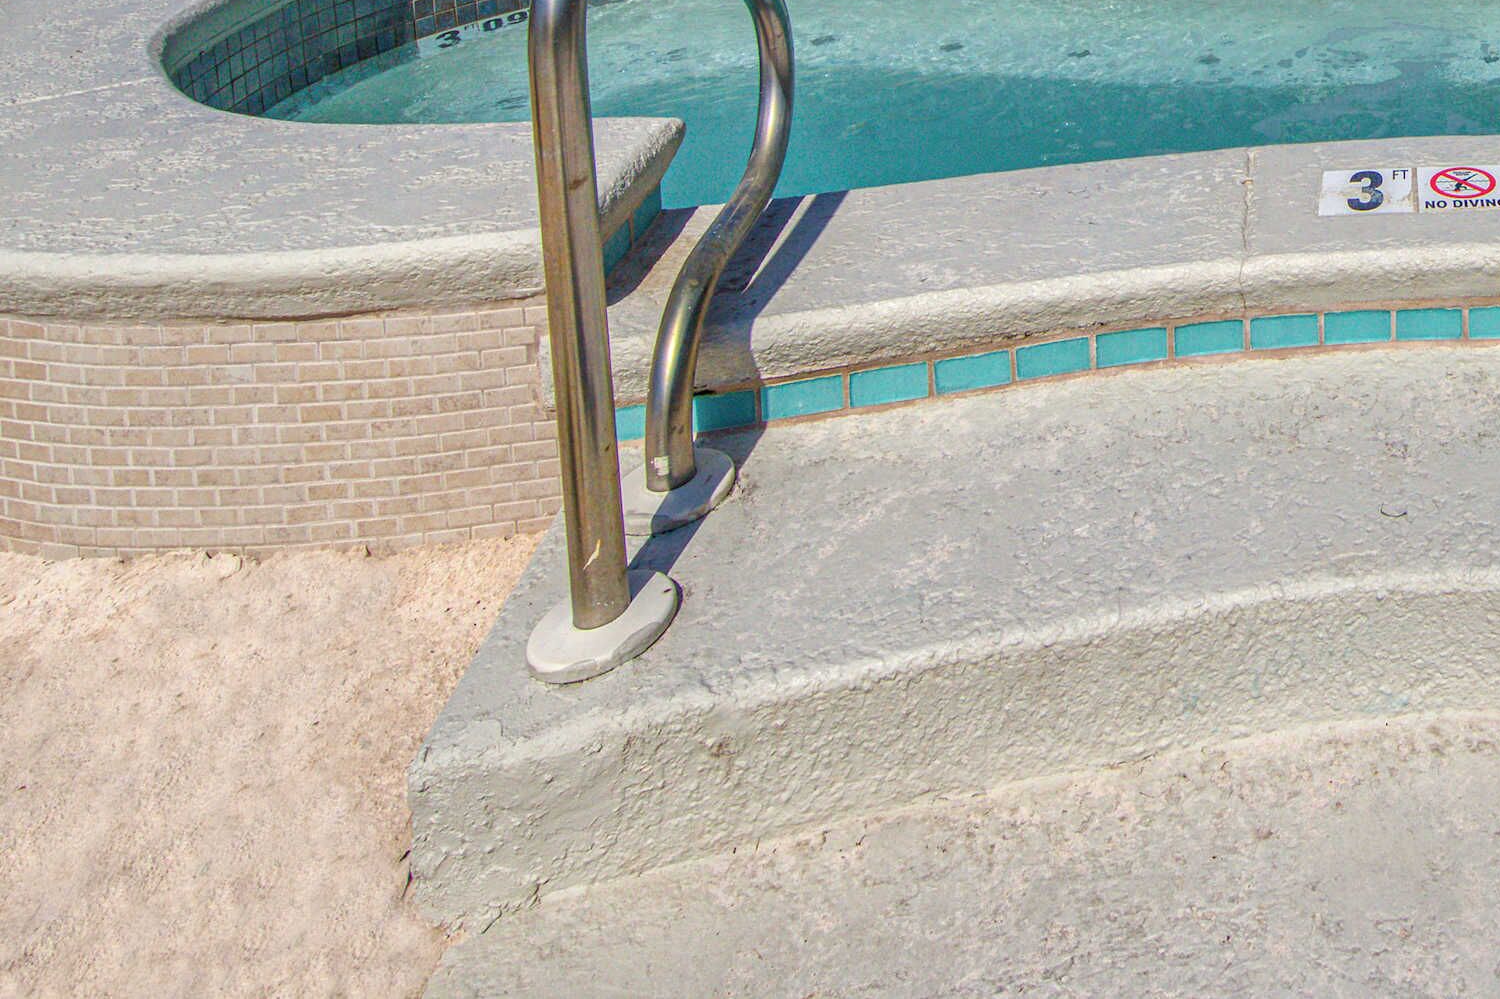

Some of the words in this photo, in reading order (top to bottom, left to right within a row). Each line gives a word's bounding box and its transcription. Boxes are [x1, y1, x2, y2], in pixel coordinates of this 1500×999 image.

[436, 30, 462, 48] 3
[1347, 170, 1384, 211] 3
[1392, 169, 1409, 181] FT
[1425, 200, 1448, 209] NO
